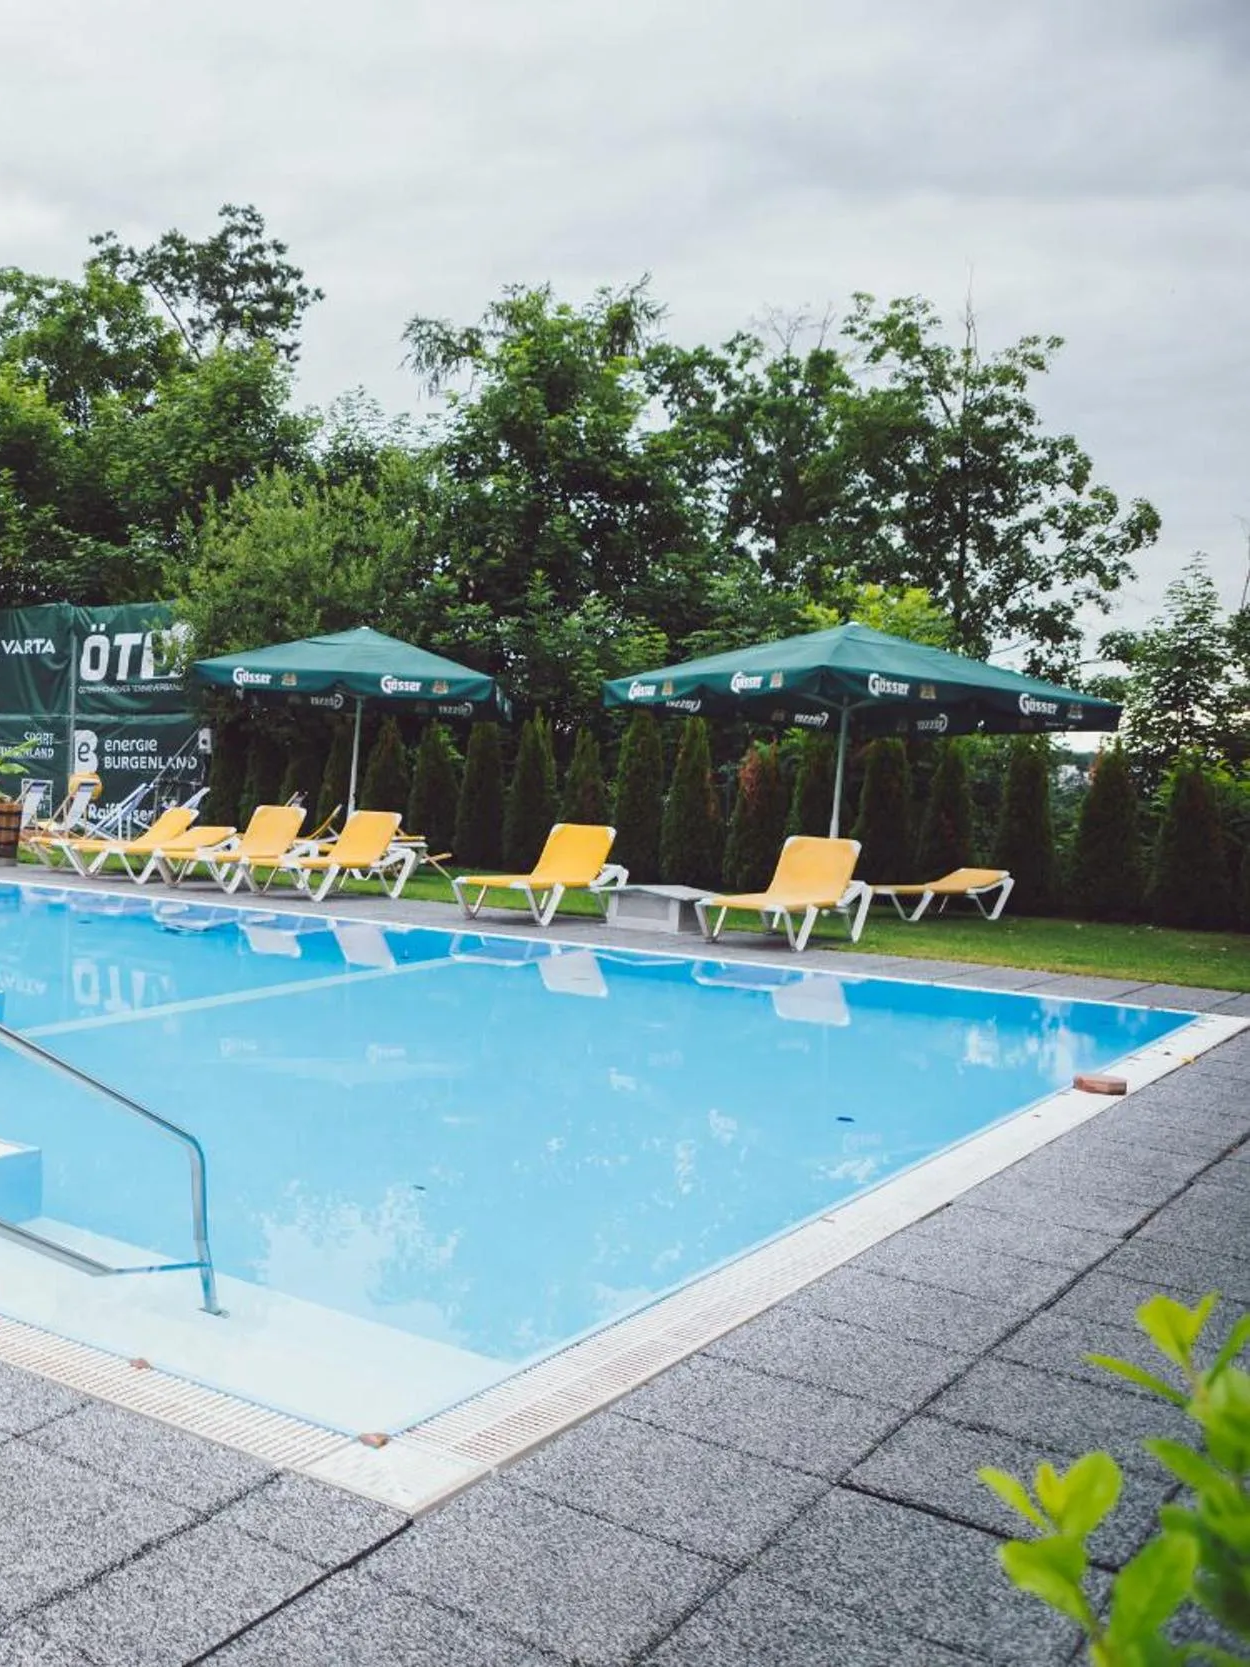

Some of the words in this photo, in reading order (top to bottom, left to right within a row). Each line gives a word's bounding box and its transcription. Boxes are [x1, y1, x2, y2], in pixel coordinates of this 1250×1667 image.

[1, 638, 56, 655] VARTA
[233, 666, 272, 686] Gösser
[380, 674, 422, 694] Gösser
[868, 673, 910, 697] Gösser
[1019, 693, 1058, 715] Gösser
[104, 738, 158, 752] energie
[104, 756, 198, 770] BURGENLAND
